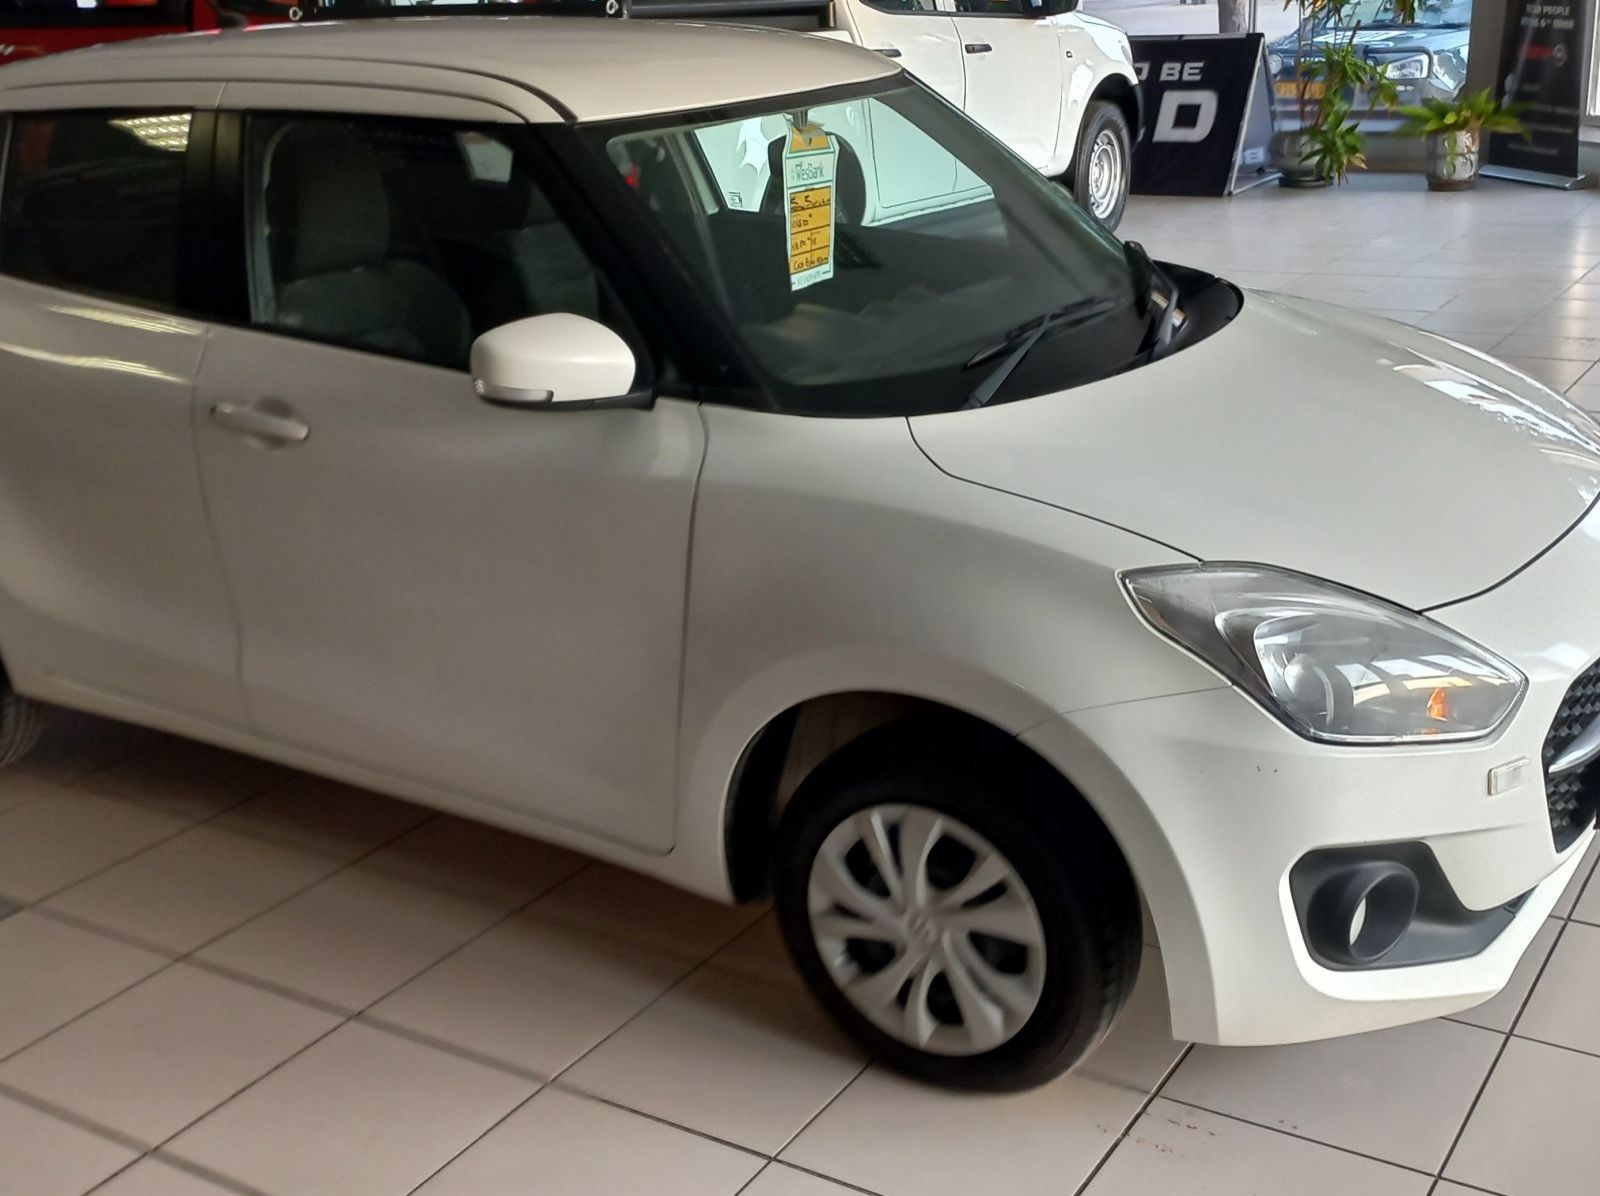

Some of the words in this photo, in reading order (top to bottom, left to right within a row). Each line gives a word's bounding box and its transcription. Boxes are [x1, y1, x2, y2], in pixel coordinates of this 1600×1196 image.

[1543, 5, 1571, 16] PEOPLE
[1159, 62, 1205, 81] BE
[1152, 89, 1219, 143] D
[795, 162, 824, 180] WesBank
